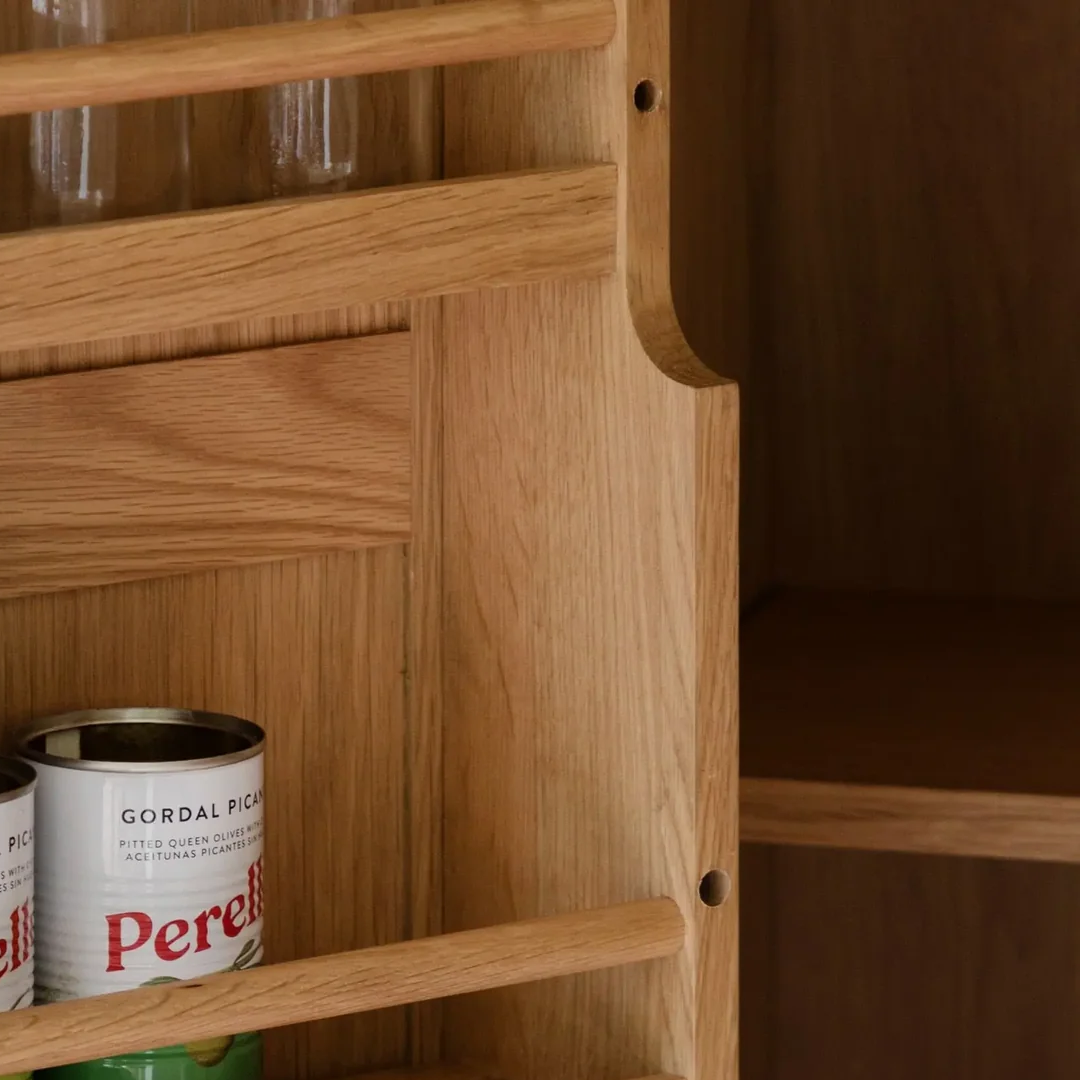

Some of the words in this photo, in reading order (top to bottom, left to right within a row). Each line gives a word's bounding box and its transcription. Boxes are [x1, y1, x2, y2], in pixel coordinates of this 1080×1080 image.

[121, 803, 220, 824] GORDAL
[120, 840, 163, 849] PITTED
[168, 836, 209, 849] QUEEN
[213, 827, 245, 843] OLIVES
[125, 849, 197, 862] ACEITUNAS
[201, 839, 246, 856] PICANTES
